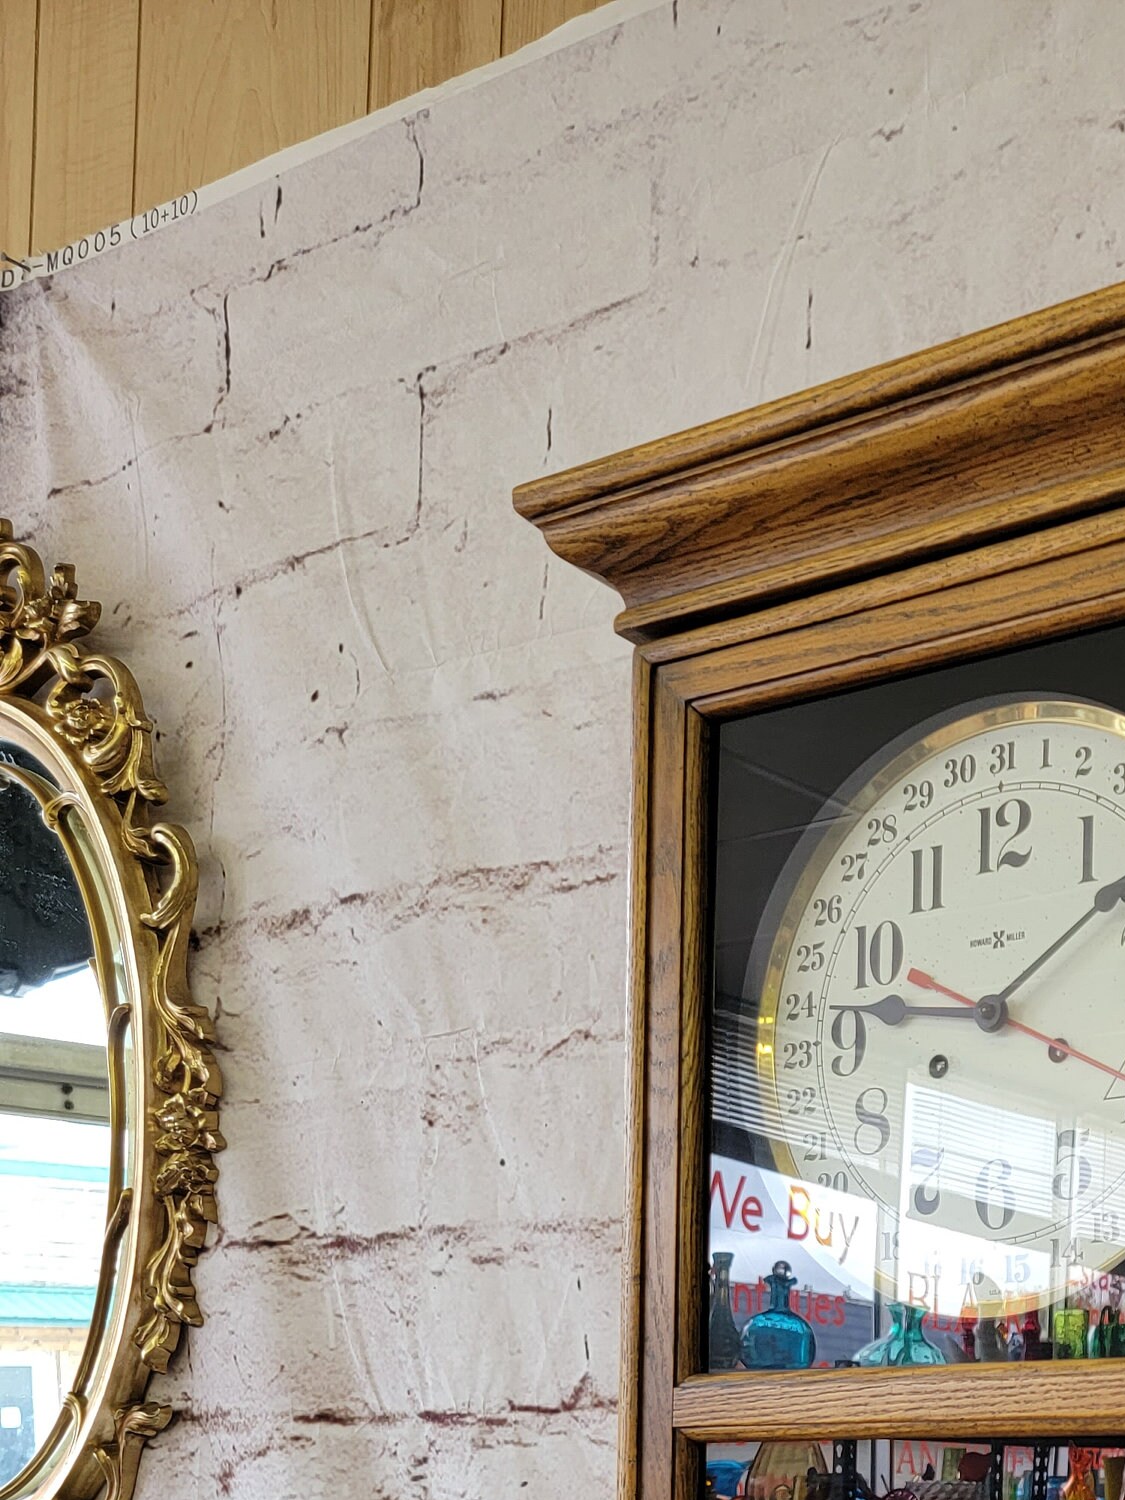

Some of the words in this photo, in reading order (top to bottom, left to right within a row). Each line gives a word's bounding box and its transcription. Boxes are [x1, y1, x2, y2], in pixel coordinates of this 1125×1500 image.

[989, 741, 1016, 774] 31
[1040, 738, 1052, 769] 1
[1075, 746, 1092, 778] 2
[944, 754, 976, 788] 30
[903, 780, 934, 813] 29
[867, 814, 897, 847] 28
[976, 799, 1032, 875] 12
[1078, 815, 1098, 884] 1
[841, 852, 868, 882] 27
[909, 845, 946, 914] 11
[813, 895, 842, 927] 26
[797, 942, 825, 972] 25
[853, 920, 904, 990] 10
[786, 991, 817, 1021] 24
[783, 1040, 813, 1070] 23
[831, 1007, 866, 1076] 9
[787, 1087, 816, 1115] 22
[854, 1087, 891, 1155] 8
[803, 1132, 827, 1160] 21
[911, 1147, 945, 1215] 7
[975, 1159, 1015, 1230] 6
[787, 1184, 860, 1266] Buy
[1091, 1212, 1120, 1243] 13
[1004, 1253, 1031, 1283] 15
[1050, 1238, 1084, 1268] 14
